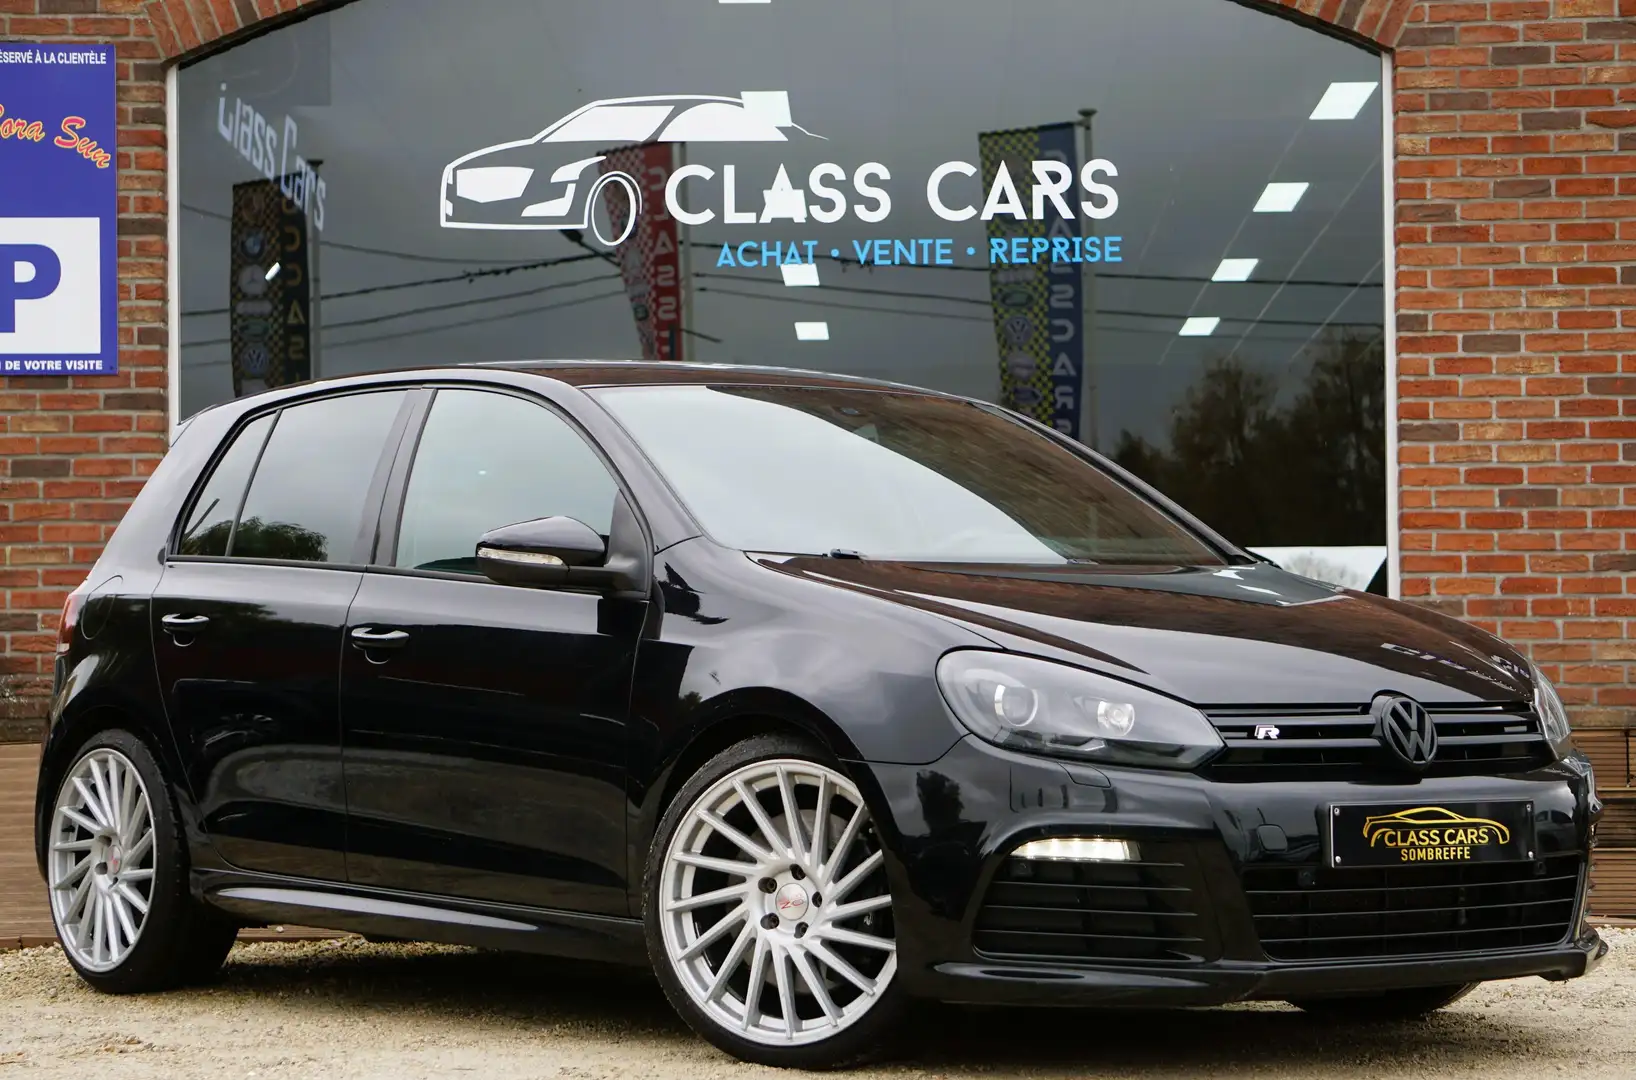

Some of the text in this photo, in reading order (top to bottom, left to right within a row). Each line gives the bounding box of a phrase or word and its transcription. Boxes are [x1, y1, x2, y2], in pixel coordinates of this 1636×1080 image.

[35, 49, 43, 64] À
[43, 52, 56, 64] LA
[57, 50, 107, 65] CLIENTÈLE
[54, 116, 111, 169] Sun
[664, 158, 1119, 225] CLASS CARS
[716, 236, 1123, 268] ACHAT VENTE REPRISE
[0, 244, 61, 333] P
[5, 360, 21, 371] DE
[23, 360, 62, 371] VOTRE
[65, 360, 103, 371] VISITE
[1254, 724, 1280, 740] R
[1384, 828, 1489, 847] CLASS CARS
[1401, 846, 1471, 861] SOMBREFFE
